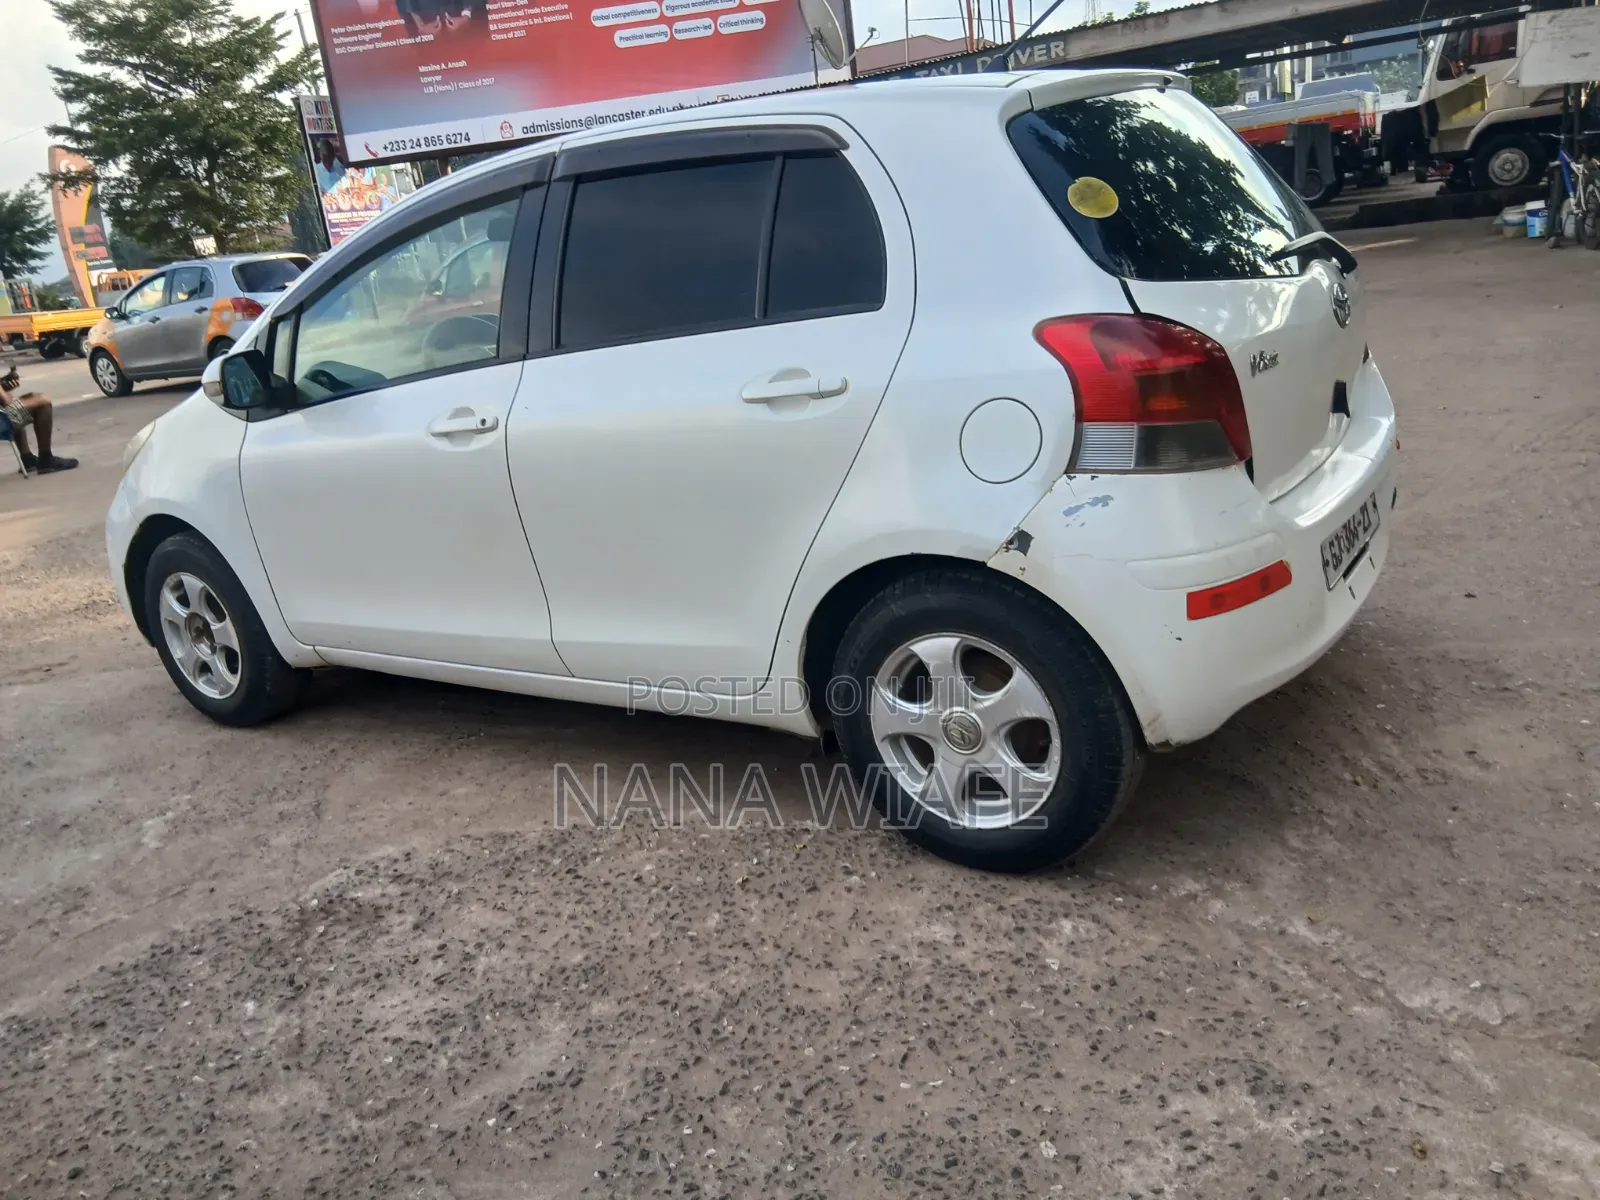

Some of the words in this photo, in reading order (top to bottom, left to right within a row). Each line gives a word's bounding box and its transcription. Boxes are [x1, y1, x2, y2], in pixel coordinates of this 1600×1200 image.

[488, 11, 525, 20] International
[525, 7, 541, 15] Trade
[541, 3, 569, 12] Executive
[665, 3, 690, 12] Rigorous
[691, 0, 720, 8] academic
[592, 13, 610, 21] Global
[611, 8, 658, 19] competitiveness
[498, 19, 528, 30] Economics
[543, 13, 570, 22] Relations
[719, 20, 740, 28] Critical
[740, 17, 764, 25] thinking
[674, 24, 712, 34] Research-led
[333, 36, 357, 44] Software
[358, 32, 382, 42] Engineer
[619, 33, 645, 42] Practical
[645, 30, 668, 38] learning
[347, 43, 375, 53] Computer
[375, 39, 397, 48] Science
[400, 37, 415, 45] Class
[977, 41, 1065, 73] DIVER
[420, 75, 442, 83] Lawyer
[458, 81, 476, 89] Class
[383, 140, 407, 152] +233
[408, 138, 422, 149] 24
[424, 135, 444, 147] 865
[445, 132, 471, 145] 6274
